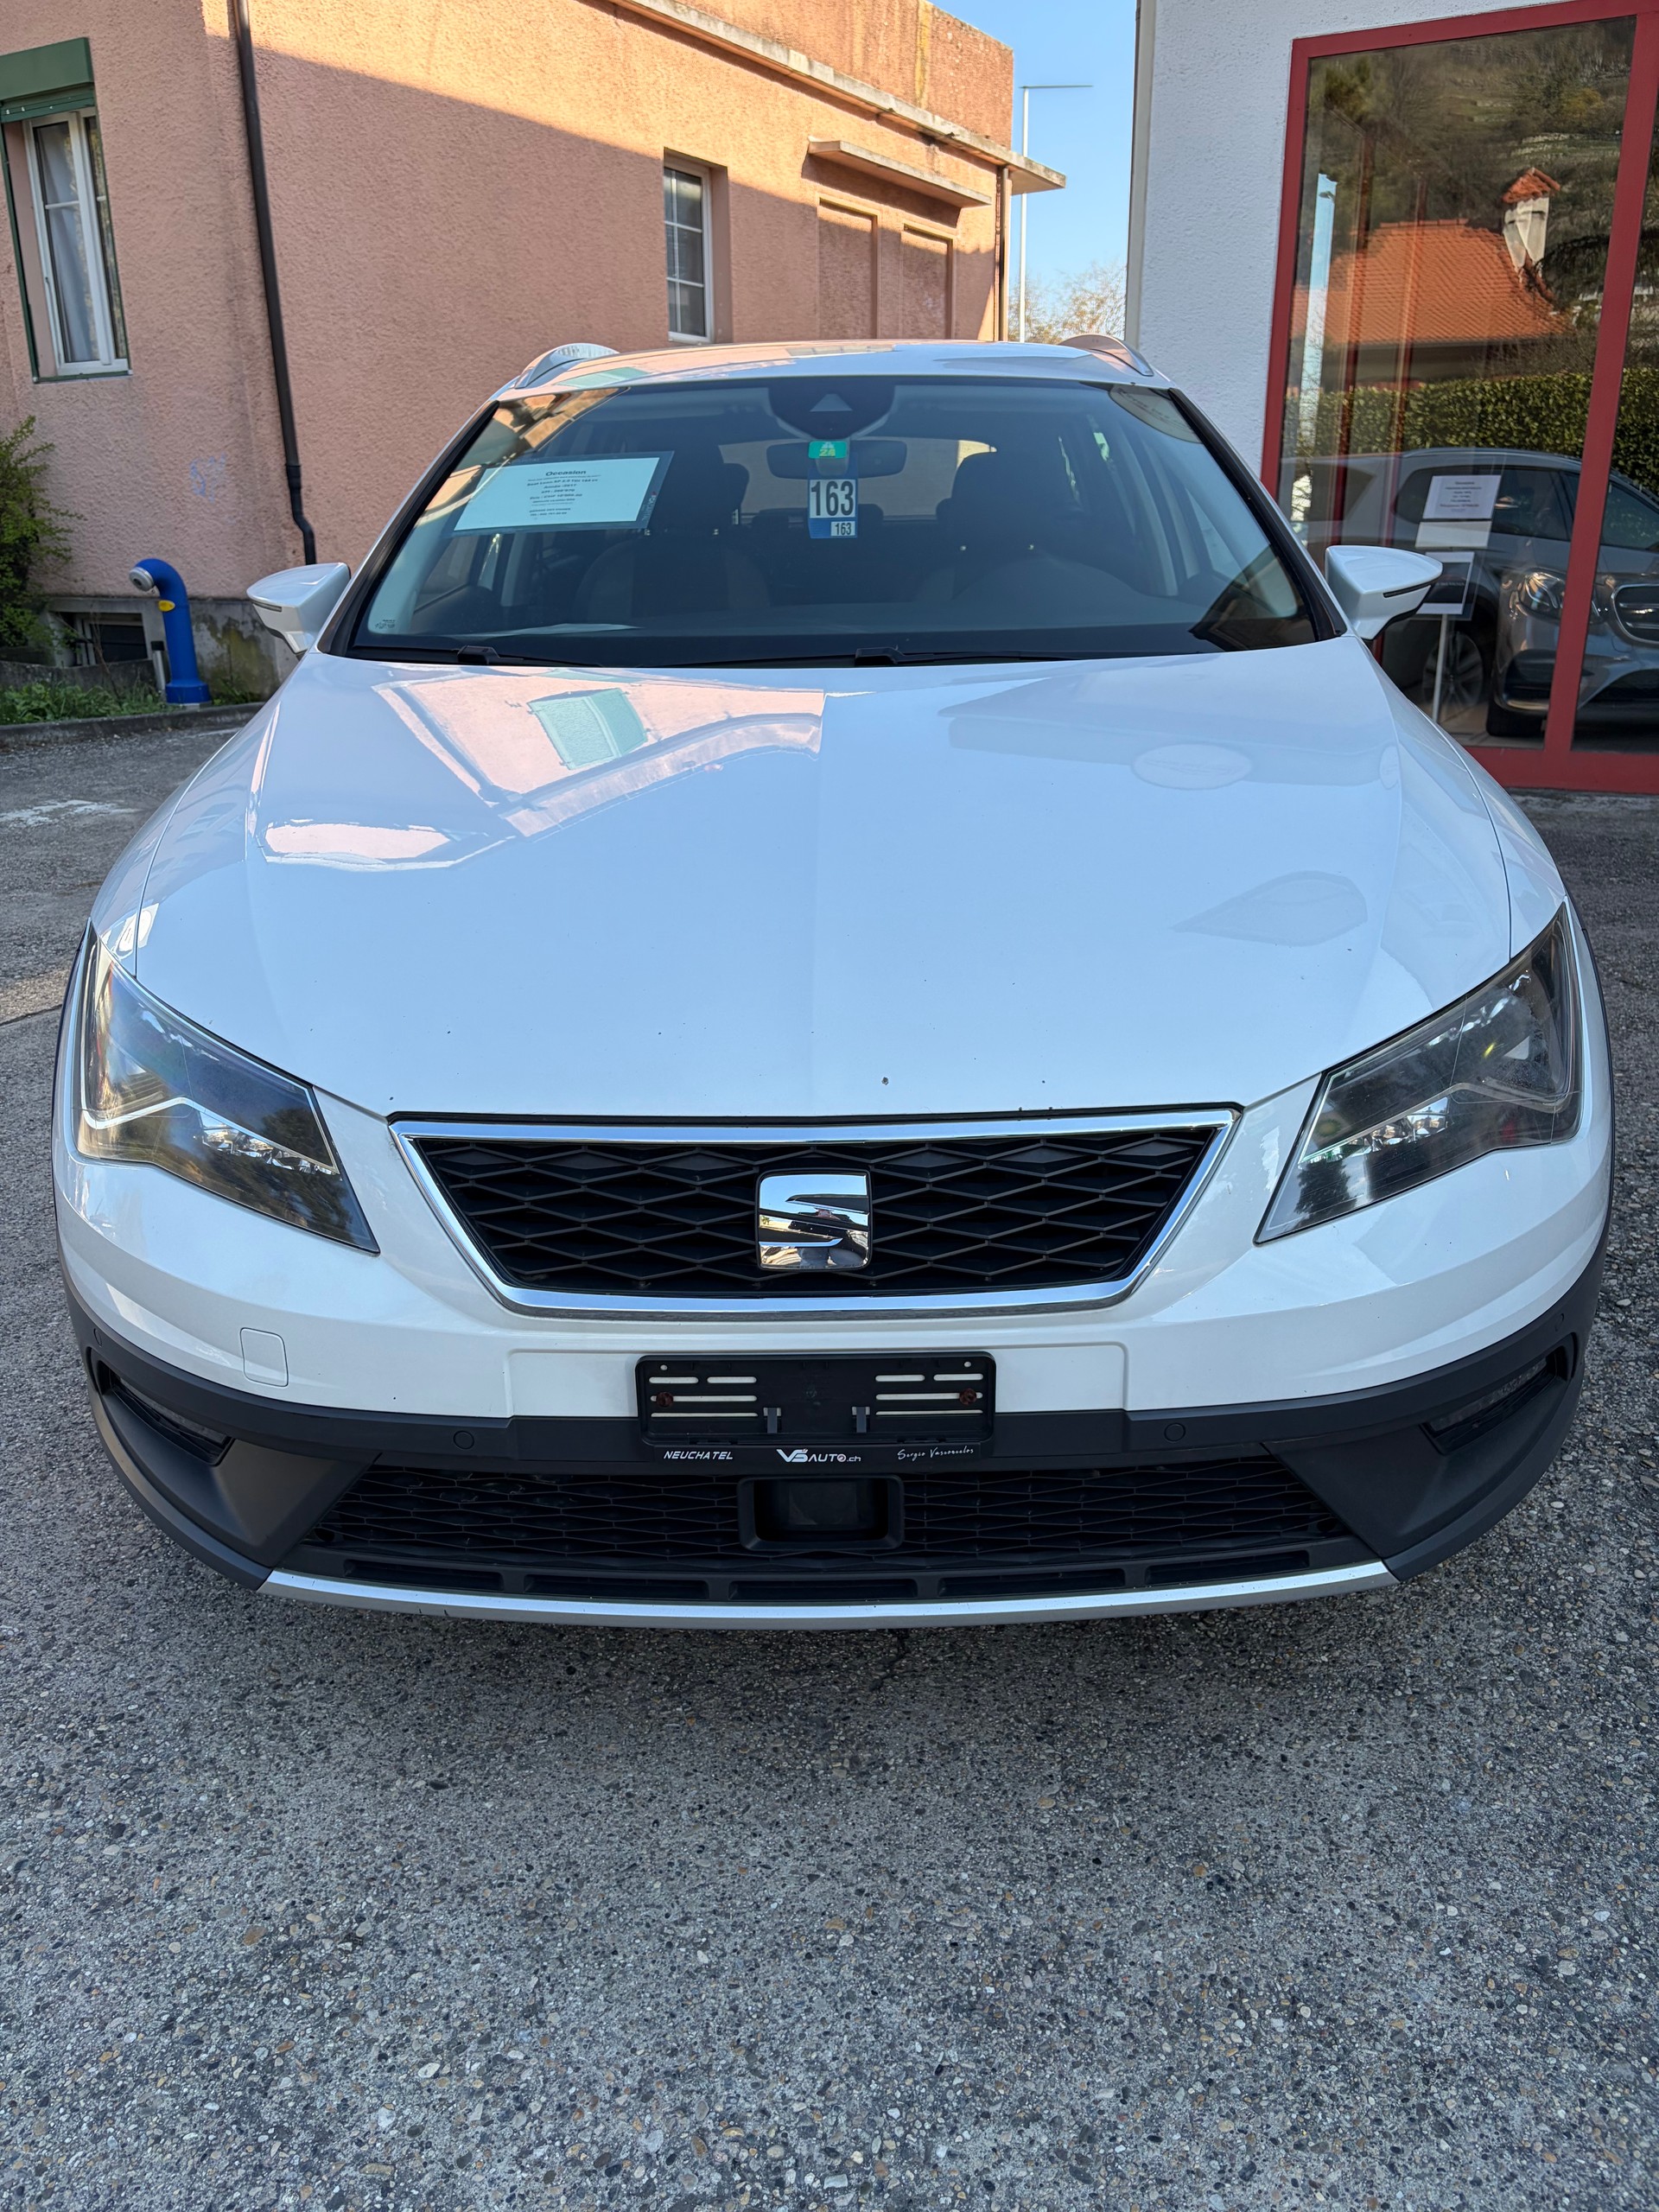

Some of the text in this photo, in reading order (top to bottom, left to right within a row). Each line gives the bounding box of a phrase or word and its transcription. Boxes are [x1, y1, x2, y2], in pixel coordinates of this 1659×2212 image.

[810, 480, 854, 517] 163
[835, 522, 852, 536] 163
[664, 1451, 734, 1460] NEUCHATEL
[897, 1449, 925, 1461] Sergio
